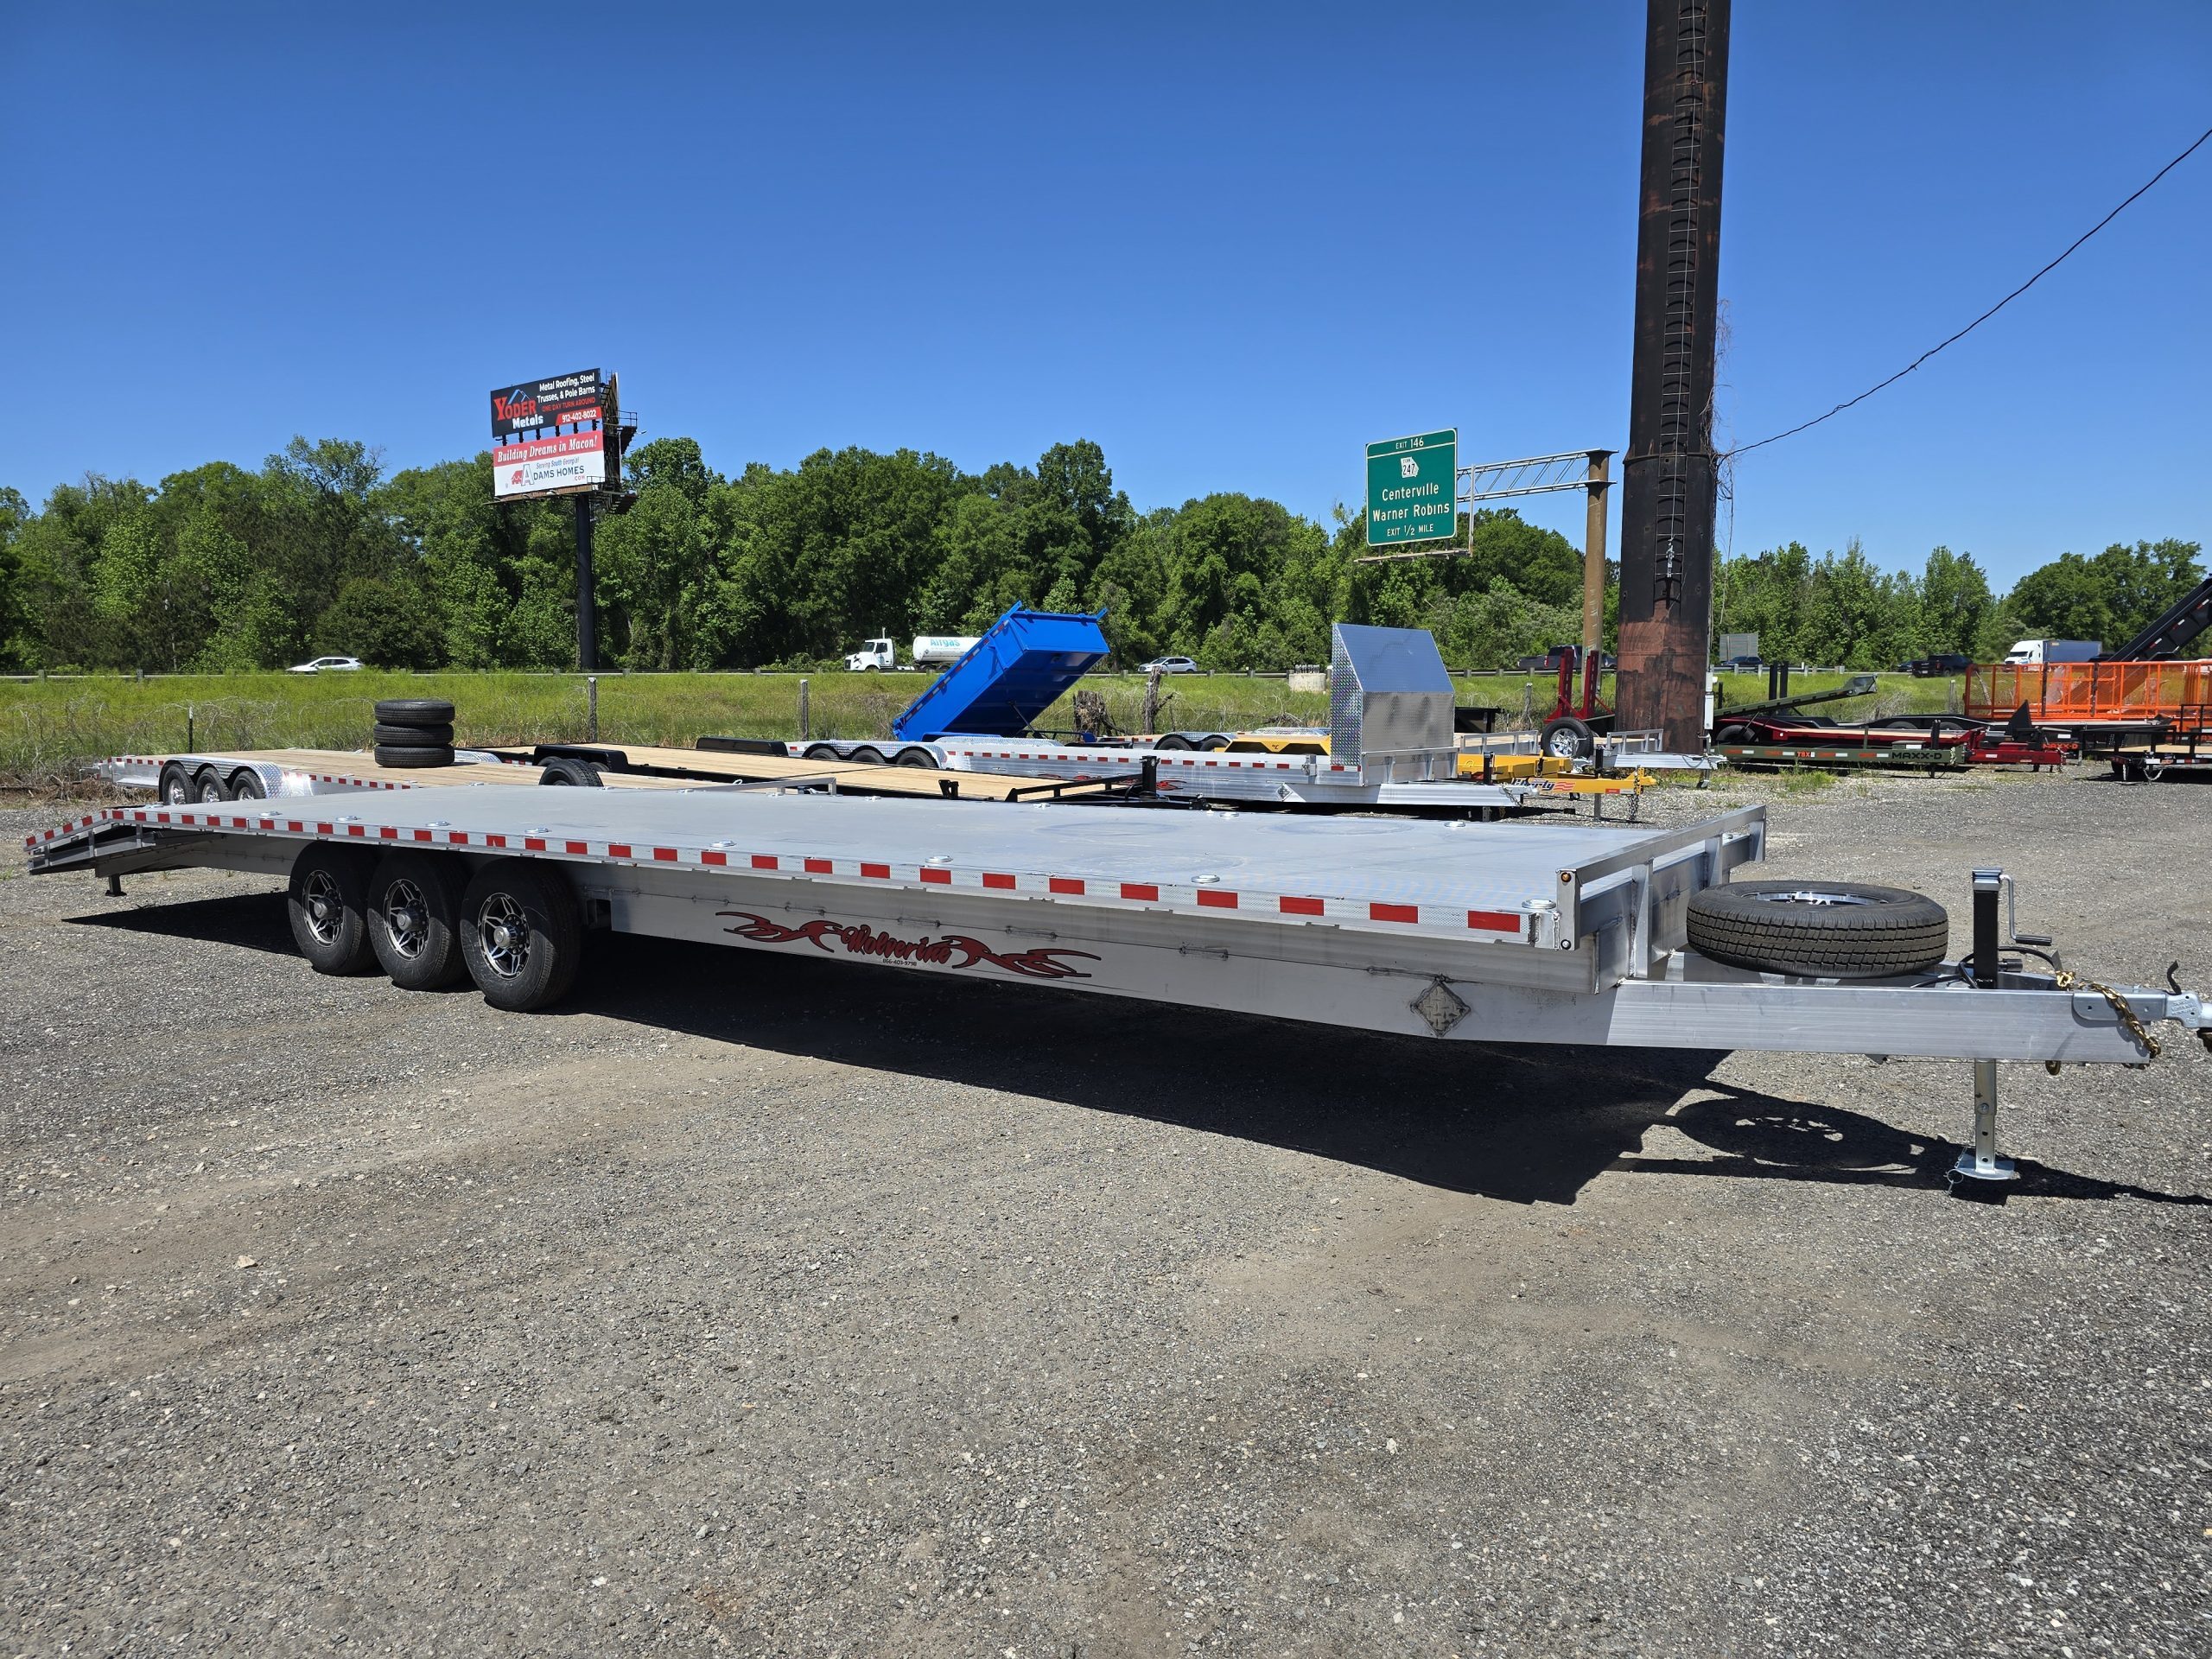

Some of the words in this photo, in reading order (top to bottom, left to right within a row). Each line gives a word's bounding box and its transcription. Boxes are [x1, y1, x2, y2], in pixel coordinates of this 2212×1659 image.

[539, 380, 555, 392] Metal
[556, 377, 579, 390] Roofing,
[580, 372, 594, 384] Steel
[537, 392, 559, 404] Trusses,
[565, 388, 578, 397] Pole
[578, 385, 595, 396] Barns
[493, 397, 536, 421] YODER
[562, 410, 596, 423] 912-402-8022
[512, 414, 543, 429] Metals
[498, 449, 528, 462] Building
[529, 444, 557, 458] Dreams
[558, 441, 567, 450] in
[569, 435, 598, 451] Macon!
[1395, 441, 1407, 449] EXIT
[1410, 437, 1424, 448] 146
[556, 465, 585, 477] HOMES
[1403, 463, 1415, 475] 247
[1382, 482, 1440, 501] Centerville
[1372, 508, 1408, 522] Warner
[1414, 503, 1450, 518] Robins
[1387, 527, 1400, 537] EXIT
[1419, 524, 1434, 533] MILE
[1891, 752, 1942, 760] MAXX-D
[841, 925, 952, 964] Wolverine
